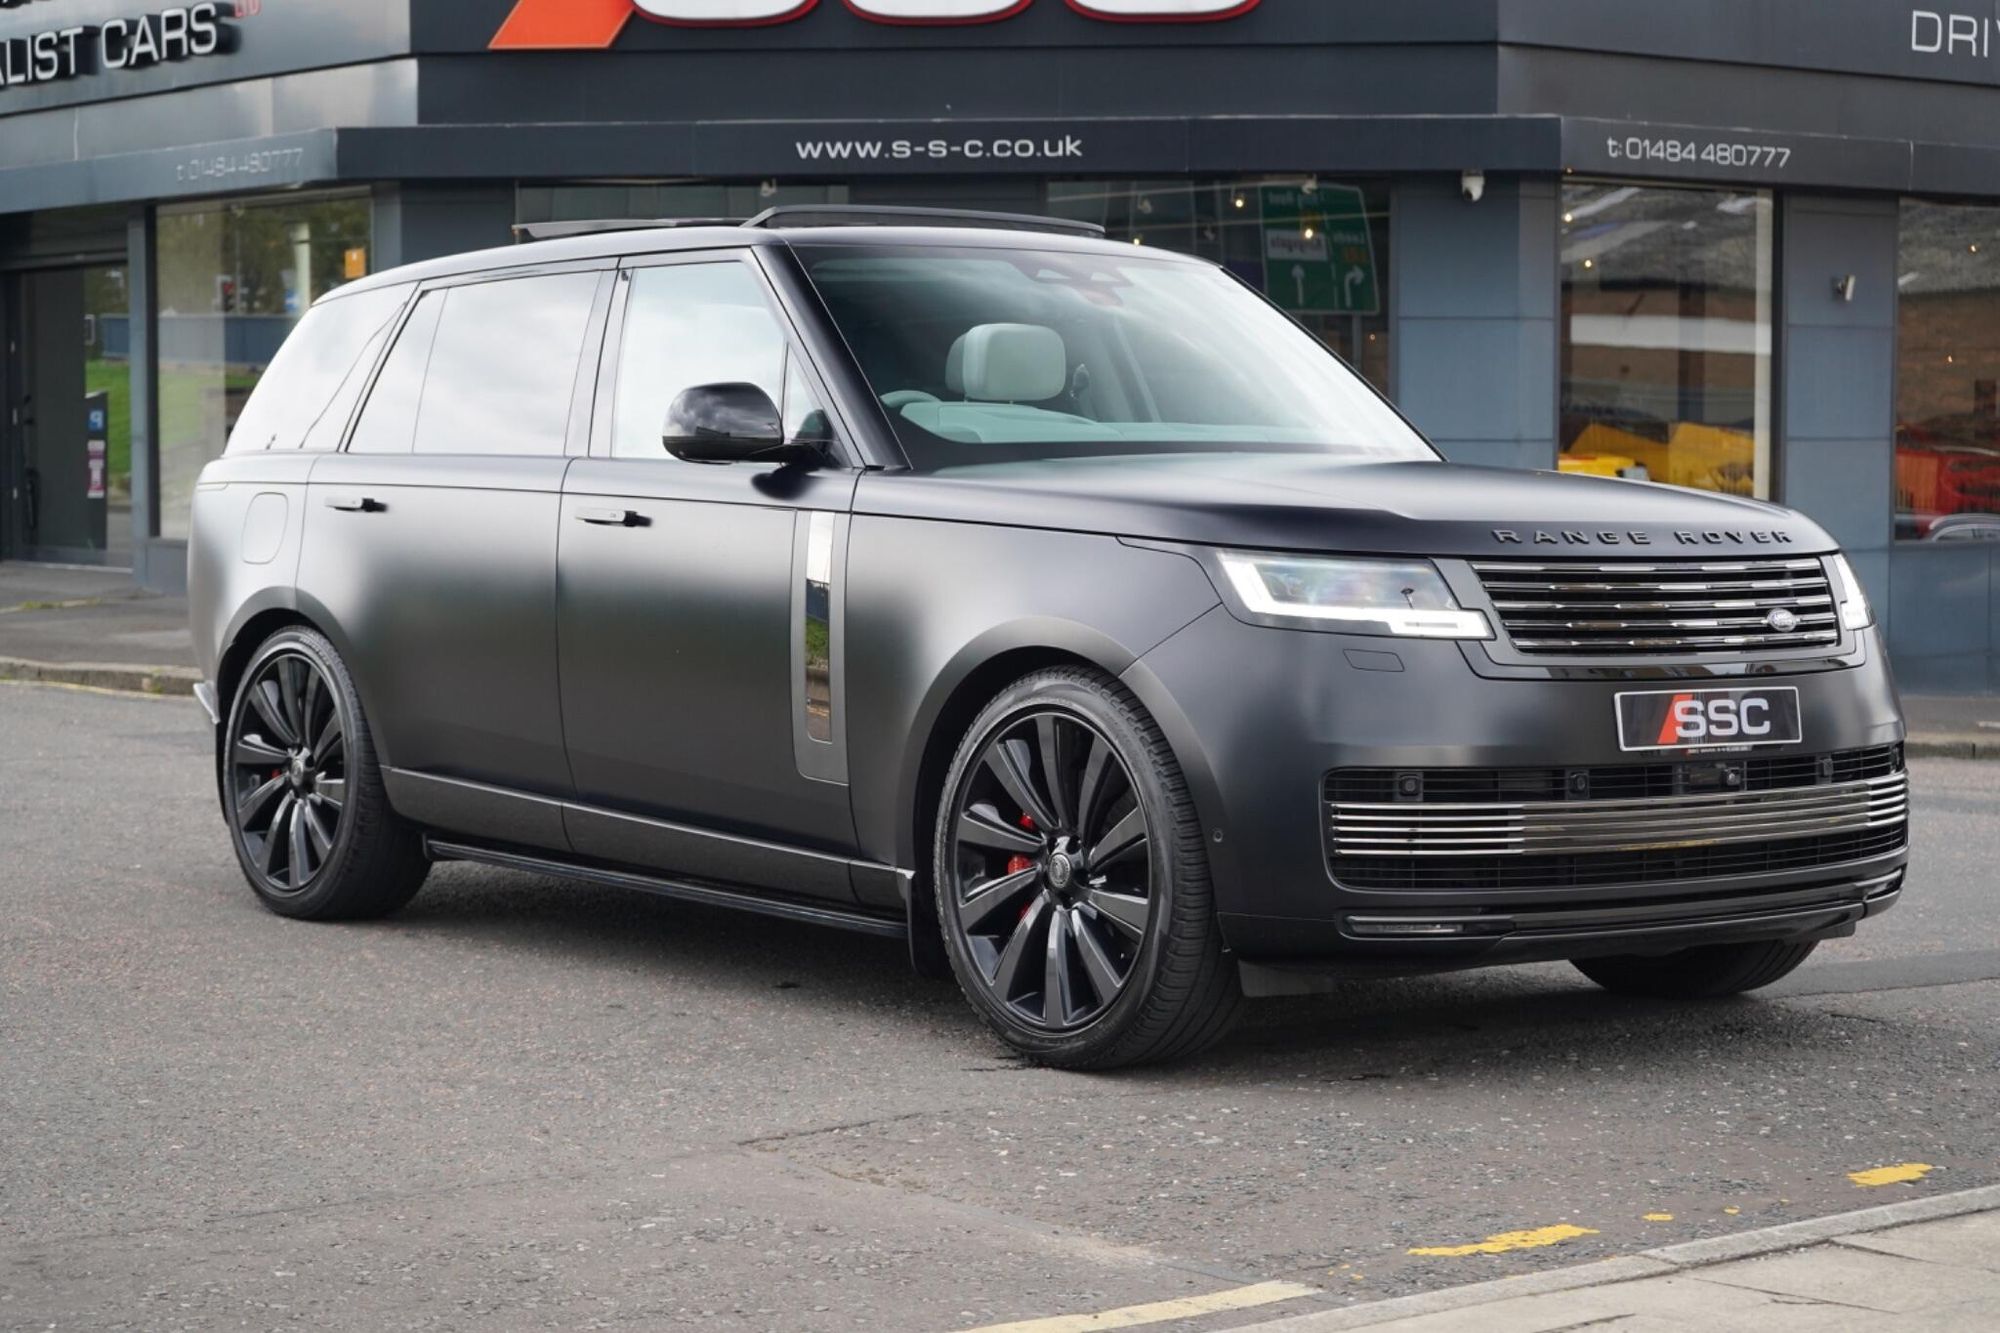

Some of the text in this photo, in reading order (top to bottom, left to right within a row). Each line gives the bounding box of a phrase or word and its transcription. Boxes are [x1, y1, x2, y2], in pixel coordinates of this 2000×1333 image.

[101, 2, 218, 69] CARS
[1911, 9, 2000, 58] DRI
[795, 135, 1083, 160] www.s-s-c.co.uk
[1699, 142, 1791, 168] 480777
[1491, 529, 1793, 545] RANGE ROVER
[1674, 697, 1771, 738] SSC
